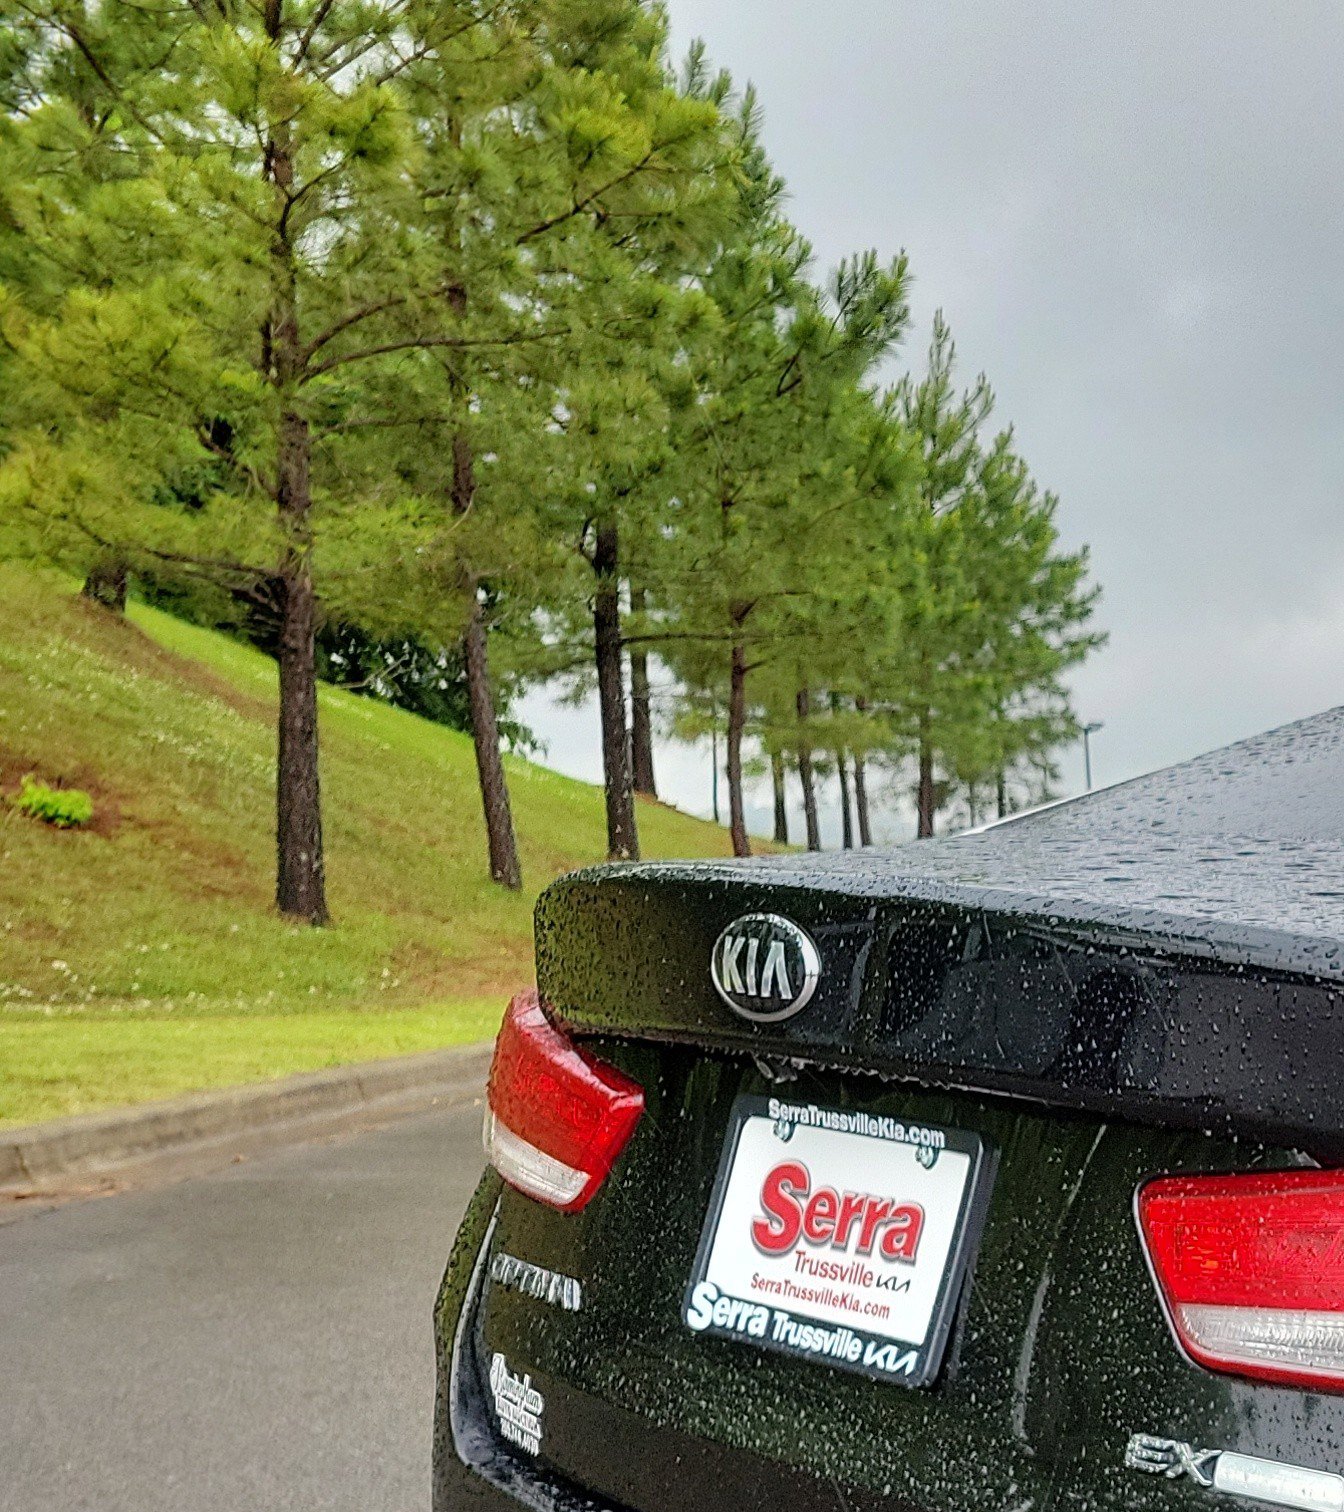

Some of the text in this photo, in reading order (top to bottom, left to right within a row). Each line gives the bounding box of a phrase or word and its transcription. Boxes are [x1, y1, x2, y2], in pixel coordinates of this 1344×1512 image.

[722, 935, 793, 1000] KIA
[768, 1099, 945, 1148] SerraTrussvilleKia.com
[752, 1160, 925, 1265] Serra
[750, 1272, 891, 1320] SerraTrussvilleKia.com
[795, 1250, 874, 1289] Trussville
[687, 1280, 769, 1338] Serra
[772, 1312, 862, 1362] Trussville
[1125, 1432, 1222, 1487] EX
